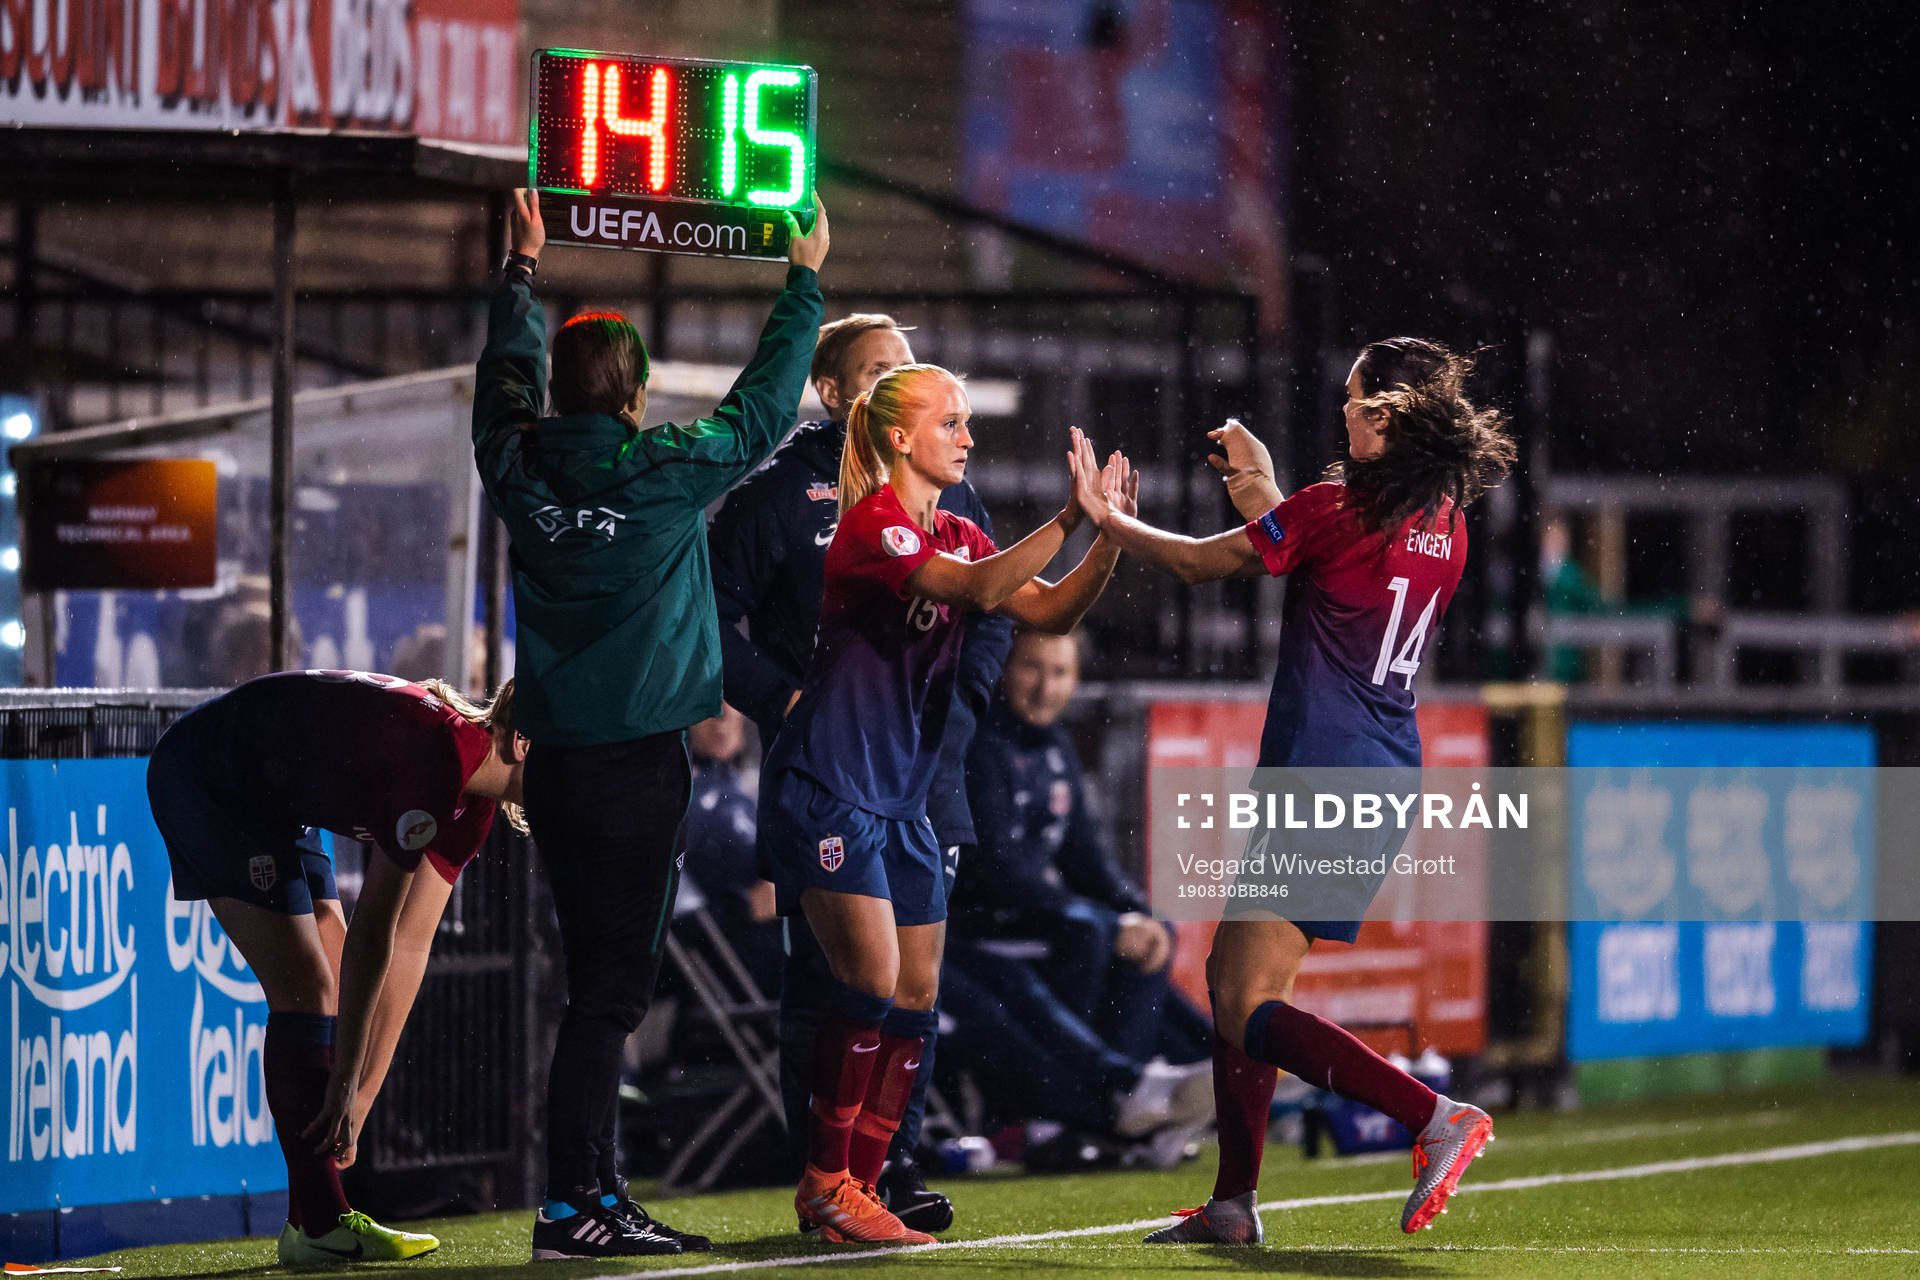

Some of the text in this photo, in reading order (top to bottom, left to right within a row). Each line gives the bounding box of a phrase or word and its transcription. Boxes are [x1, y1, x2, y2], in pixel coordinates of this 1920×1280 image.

[581, 62, 669, 192] 14
[720, 70, 806, 208] 15
[569, 205, 746, 250] UEFA.com
[1406, 528, 1452, 561] ENGEN
[1371, 576, 1442, 691] 14
[9, 972, 138, 1162] Ireland
[190, 975, 273, 1147] Irela
